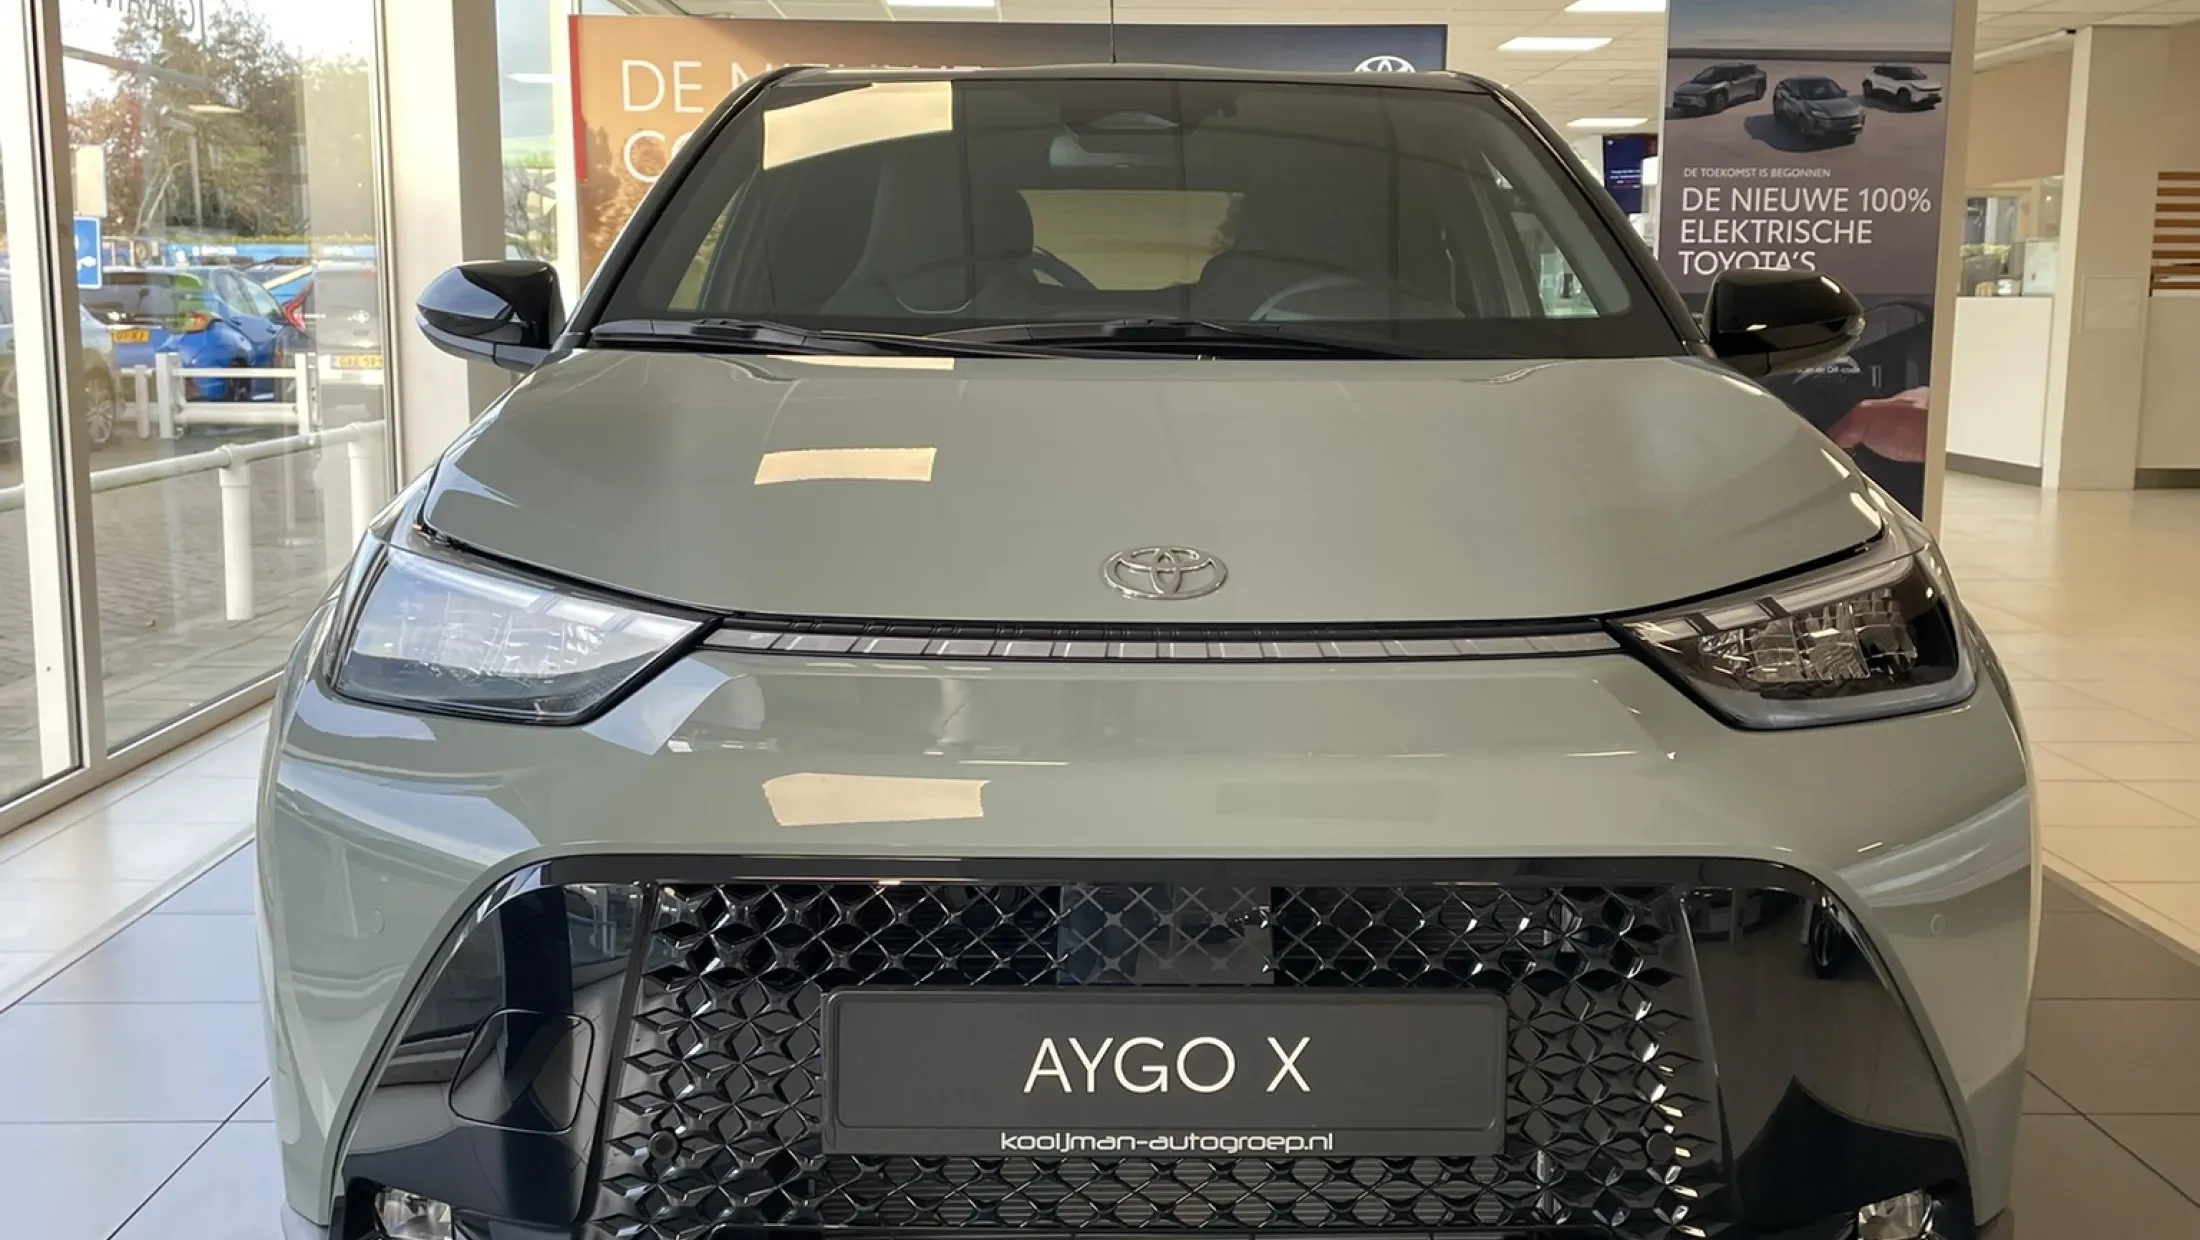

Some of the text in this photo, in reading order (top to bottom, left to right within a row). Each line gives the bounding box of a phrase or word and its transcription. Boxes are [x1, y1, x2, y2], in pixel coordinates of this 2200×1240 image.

[622, 60, 704, 113] DE
[1684, 168, 1831, 178] DE TOEKOMST IS BEGONNEN
[1682, 187, 1932, 213] DE NIEUWE 100%
[1680, 219, 1873, 244] ELEKTRISCHE
[1023, 1036, 1312, 1093] AYGO X
